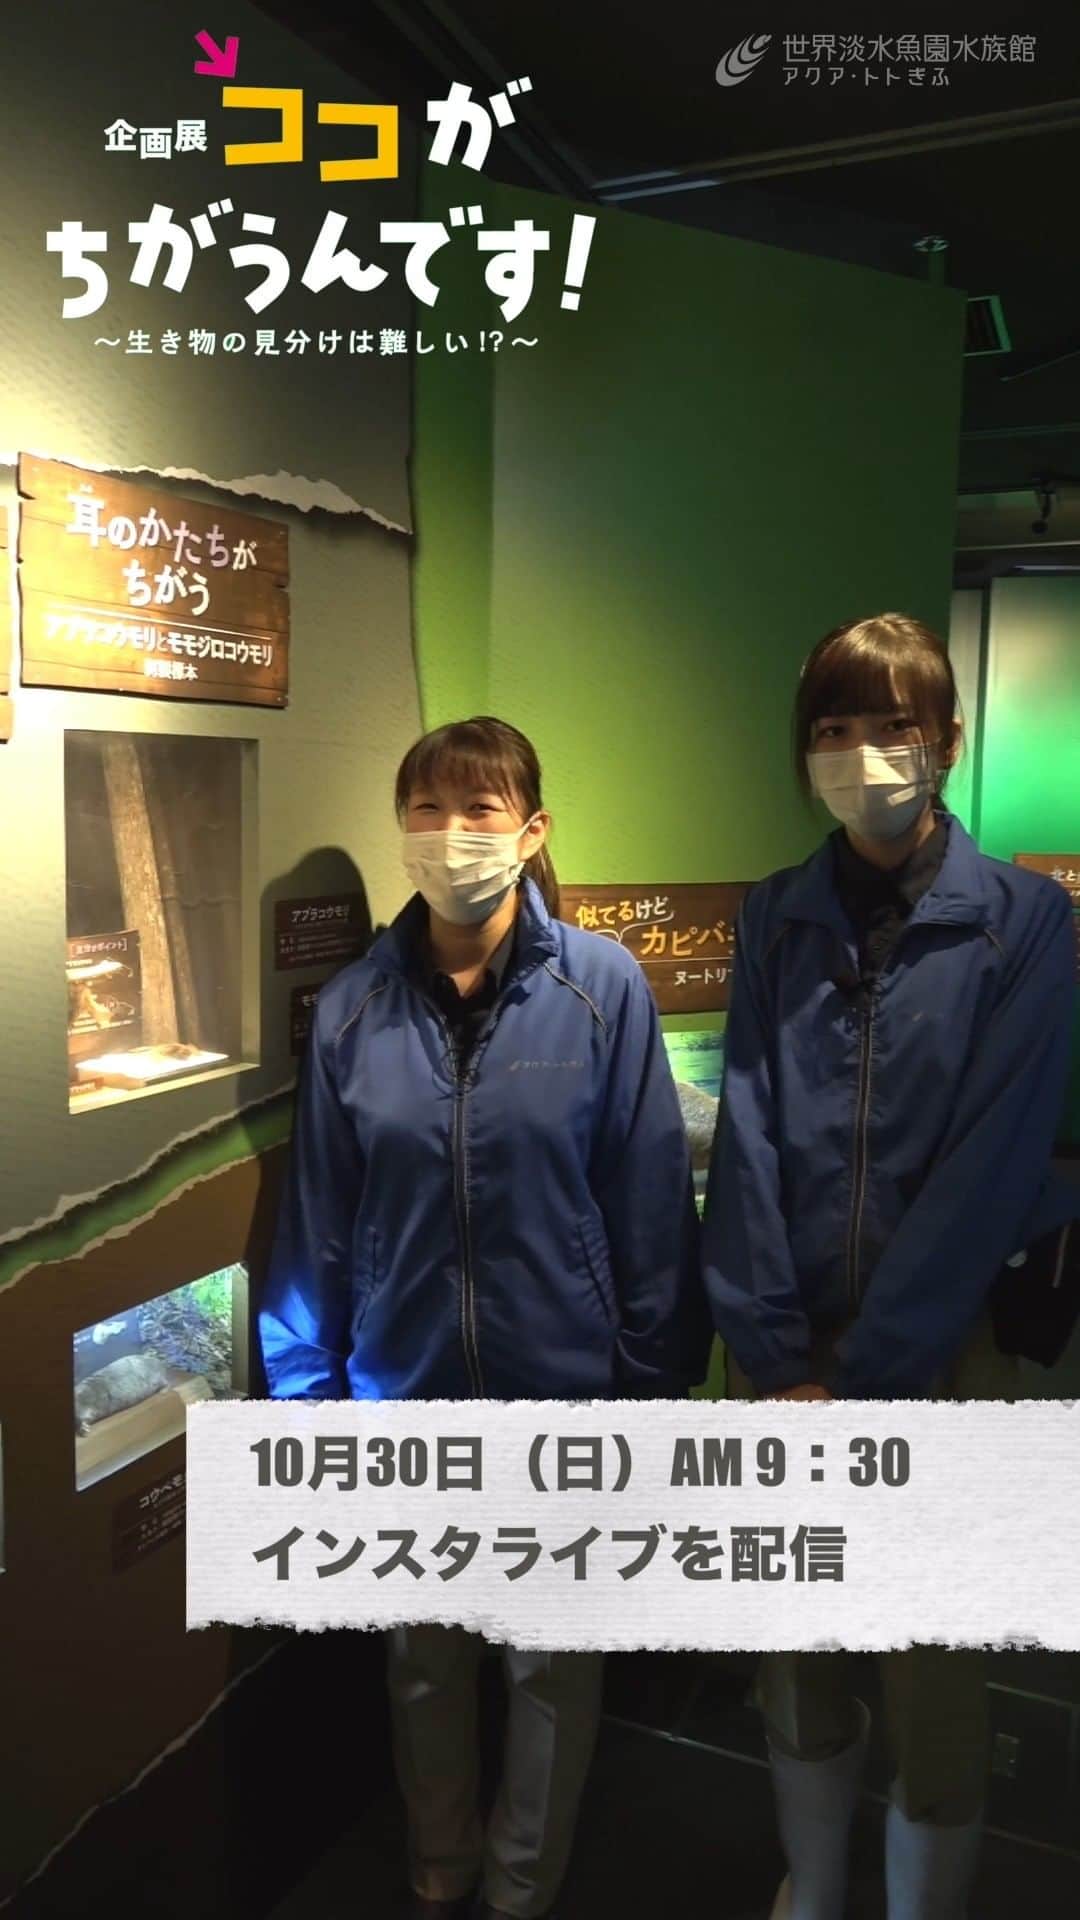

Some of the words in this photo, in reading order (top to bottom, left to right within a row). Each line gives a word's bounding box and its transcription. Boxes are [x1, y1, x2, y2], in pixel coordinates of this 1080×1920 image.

[67, 492, 257, 570] 耳のかたちが
[122, 558, 210, 616] ちがう
[576, 896, 670, 928] 似てるけど
[674, 968, 733, 985] ヌートリ
